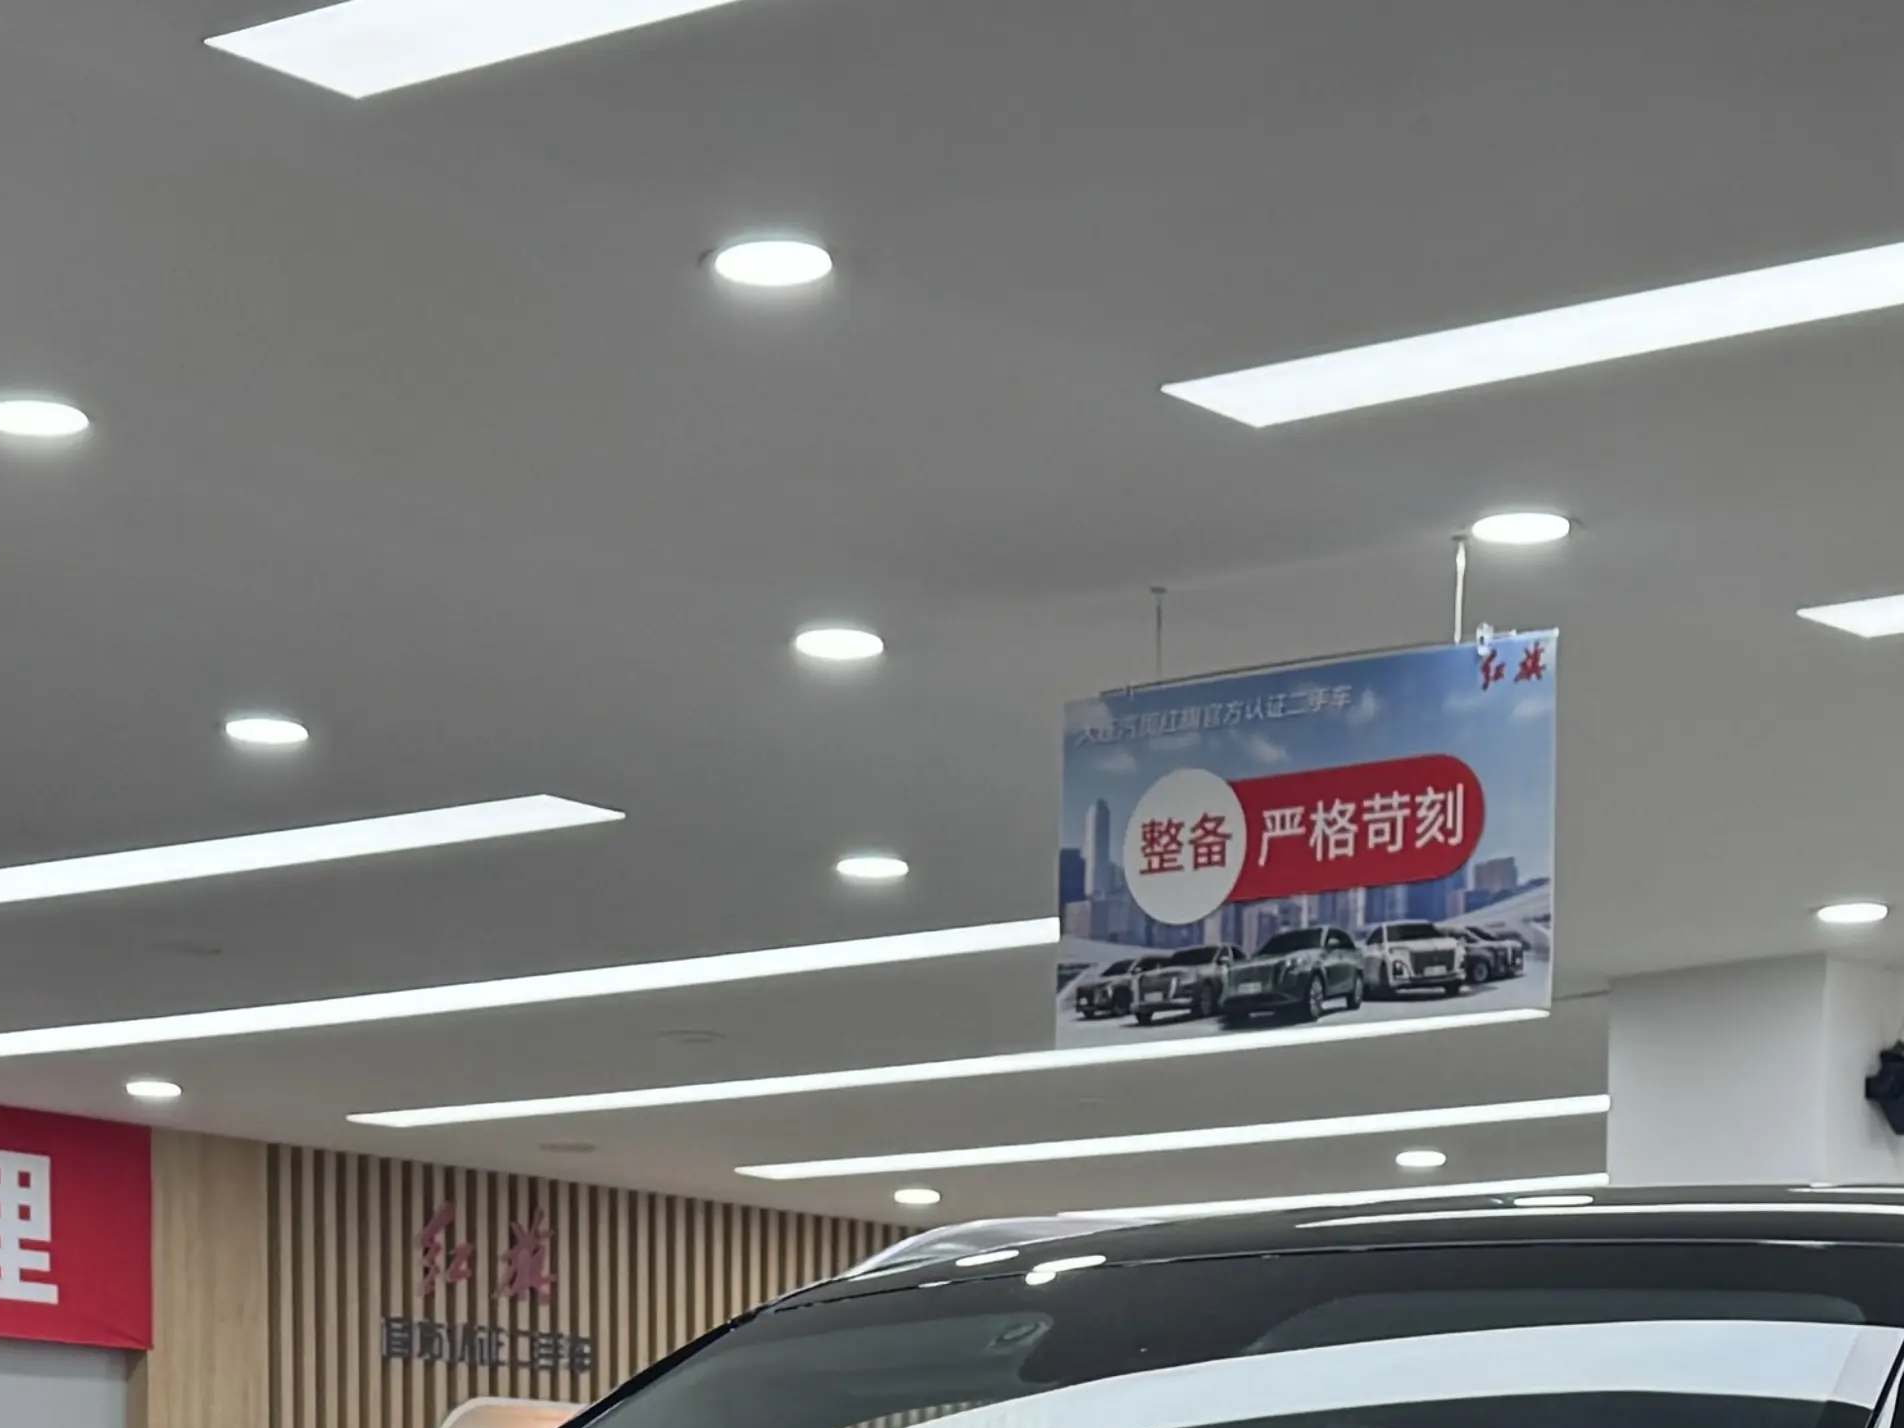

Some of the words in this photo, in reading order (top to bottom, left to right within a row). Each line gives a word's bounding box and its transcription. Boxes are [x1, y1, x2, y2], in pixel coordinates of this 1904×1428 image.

[1139, 812, 1233, 875] 整备
[1257, 783, 1465, 868] 严格苛刻
